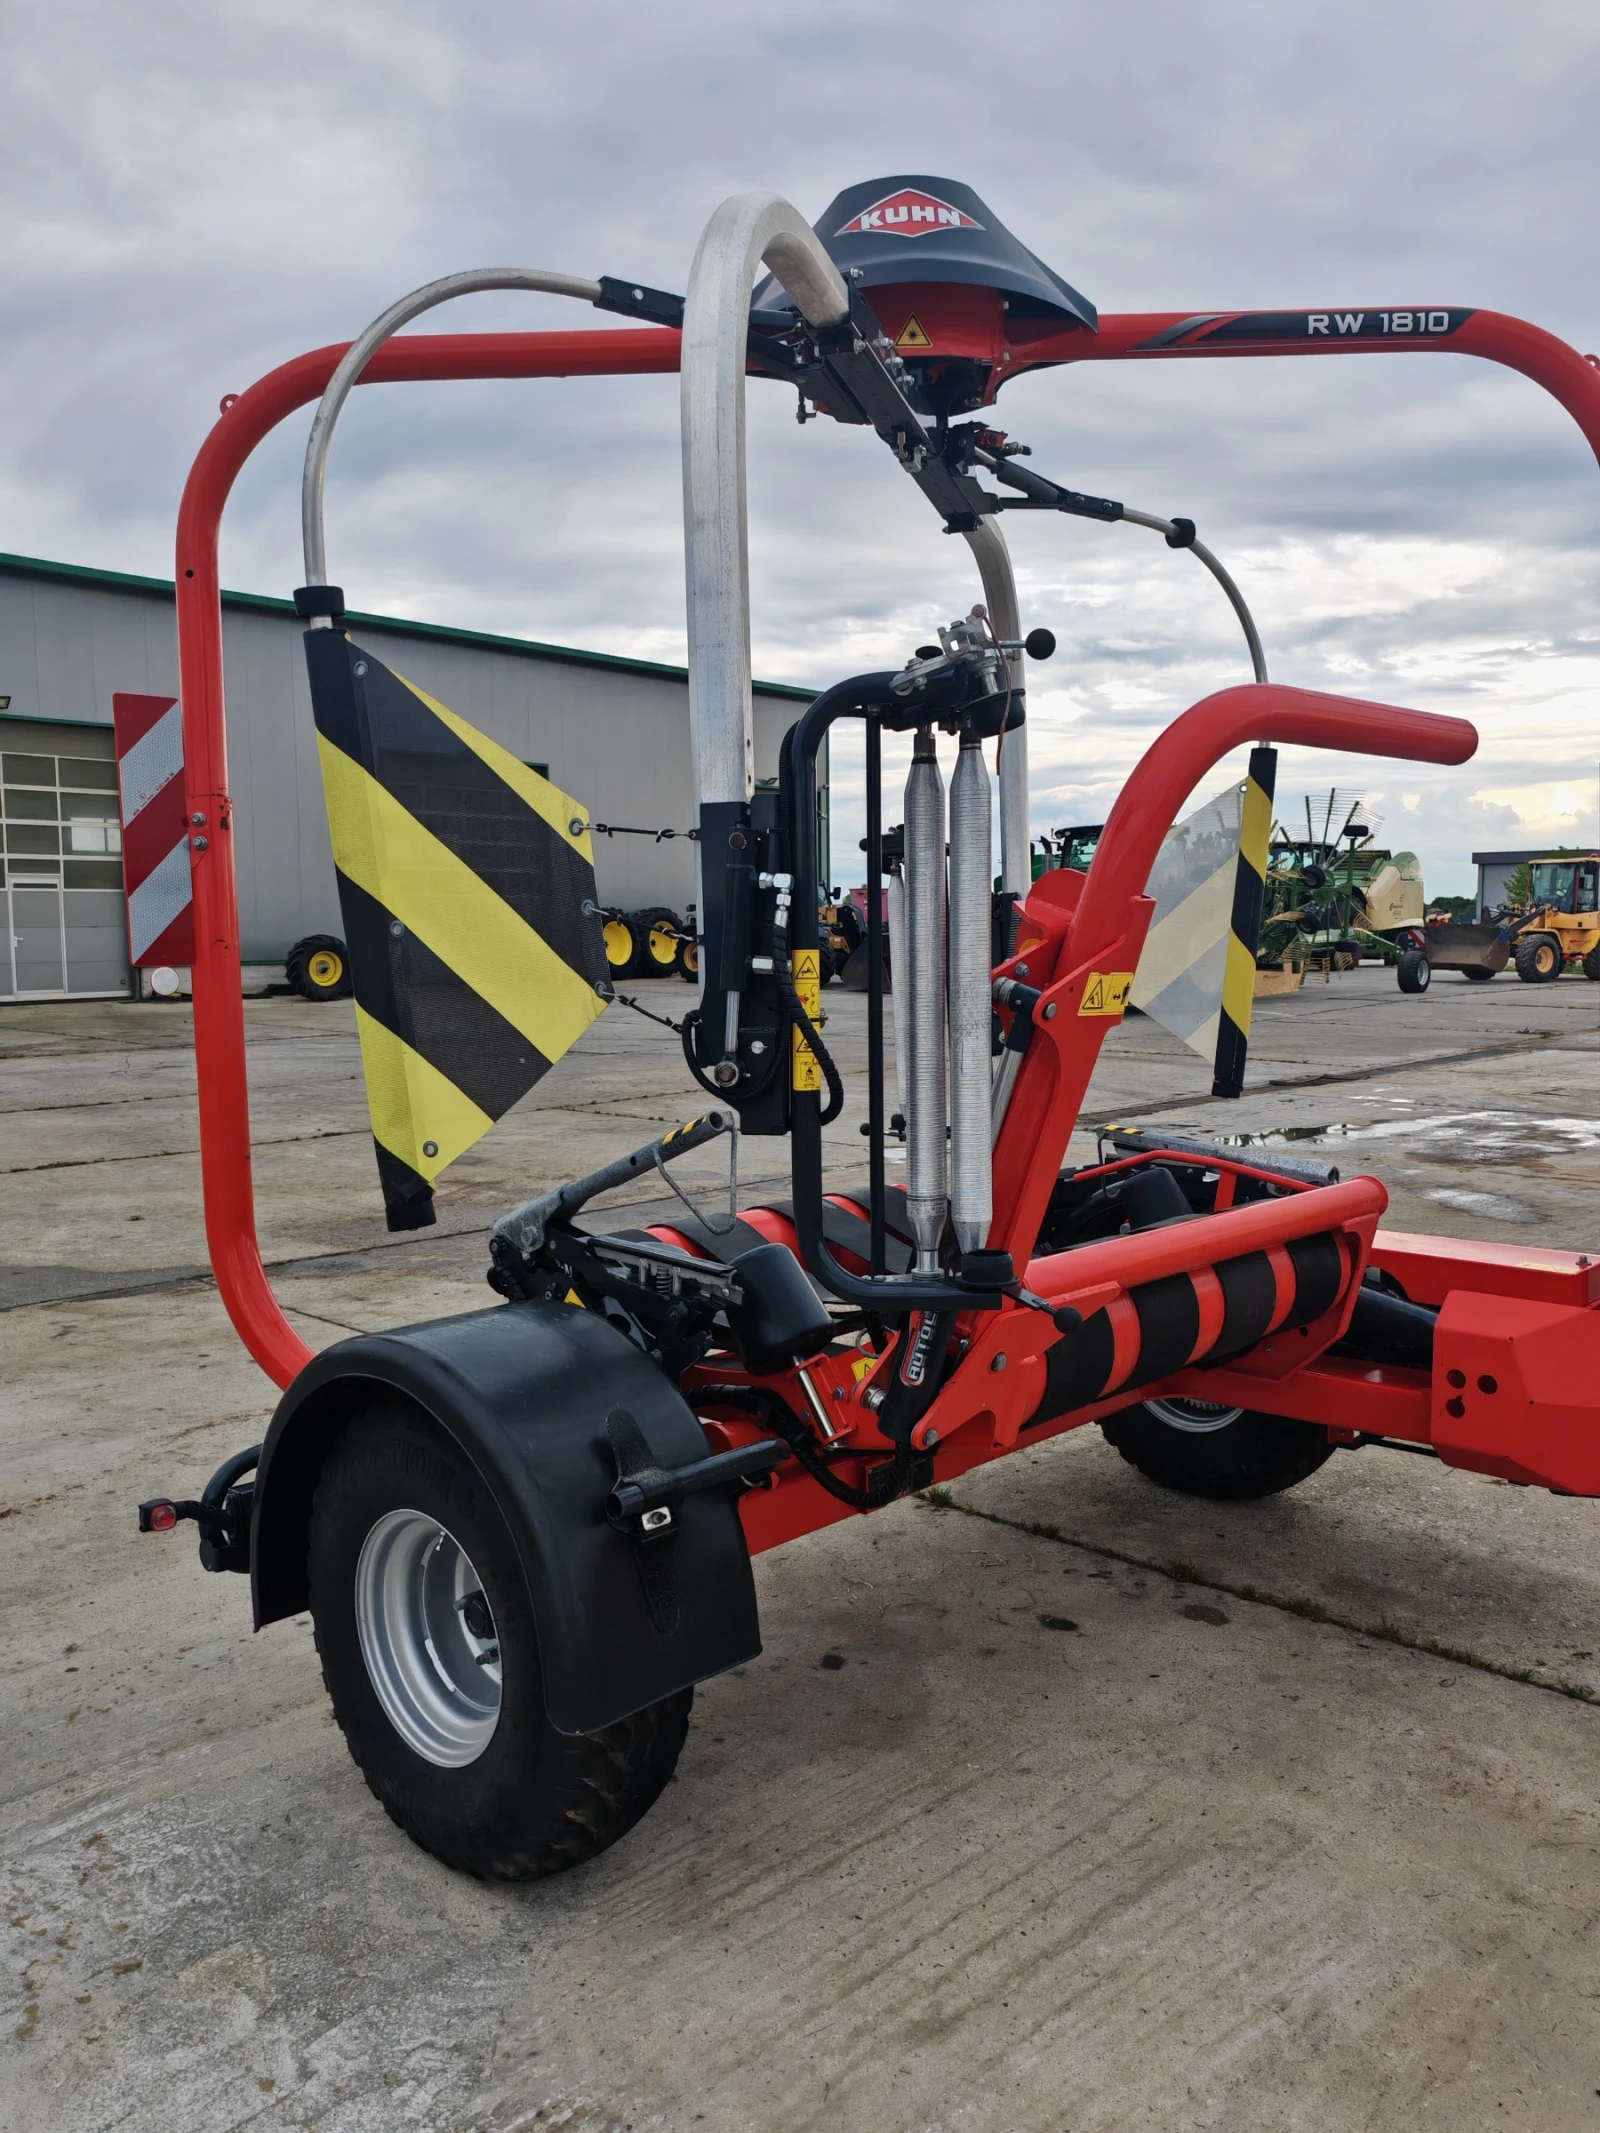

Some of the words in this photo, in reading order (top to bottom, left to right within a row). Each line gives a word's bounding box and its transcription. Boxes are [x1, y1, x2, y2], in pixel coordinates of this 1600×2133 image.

[861, 205, 961, 231] KUHN
[1307, 313, 1365, 335] RW
[1380, 311, 1449, 333] 1810
